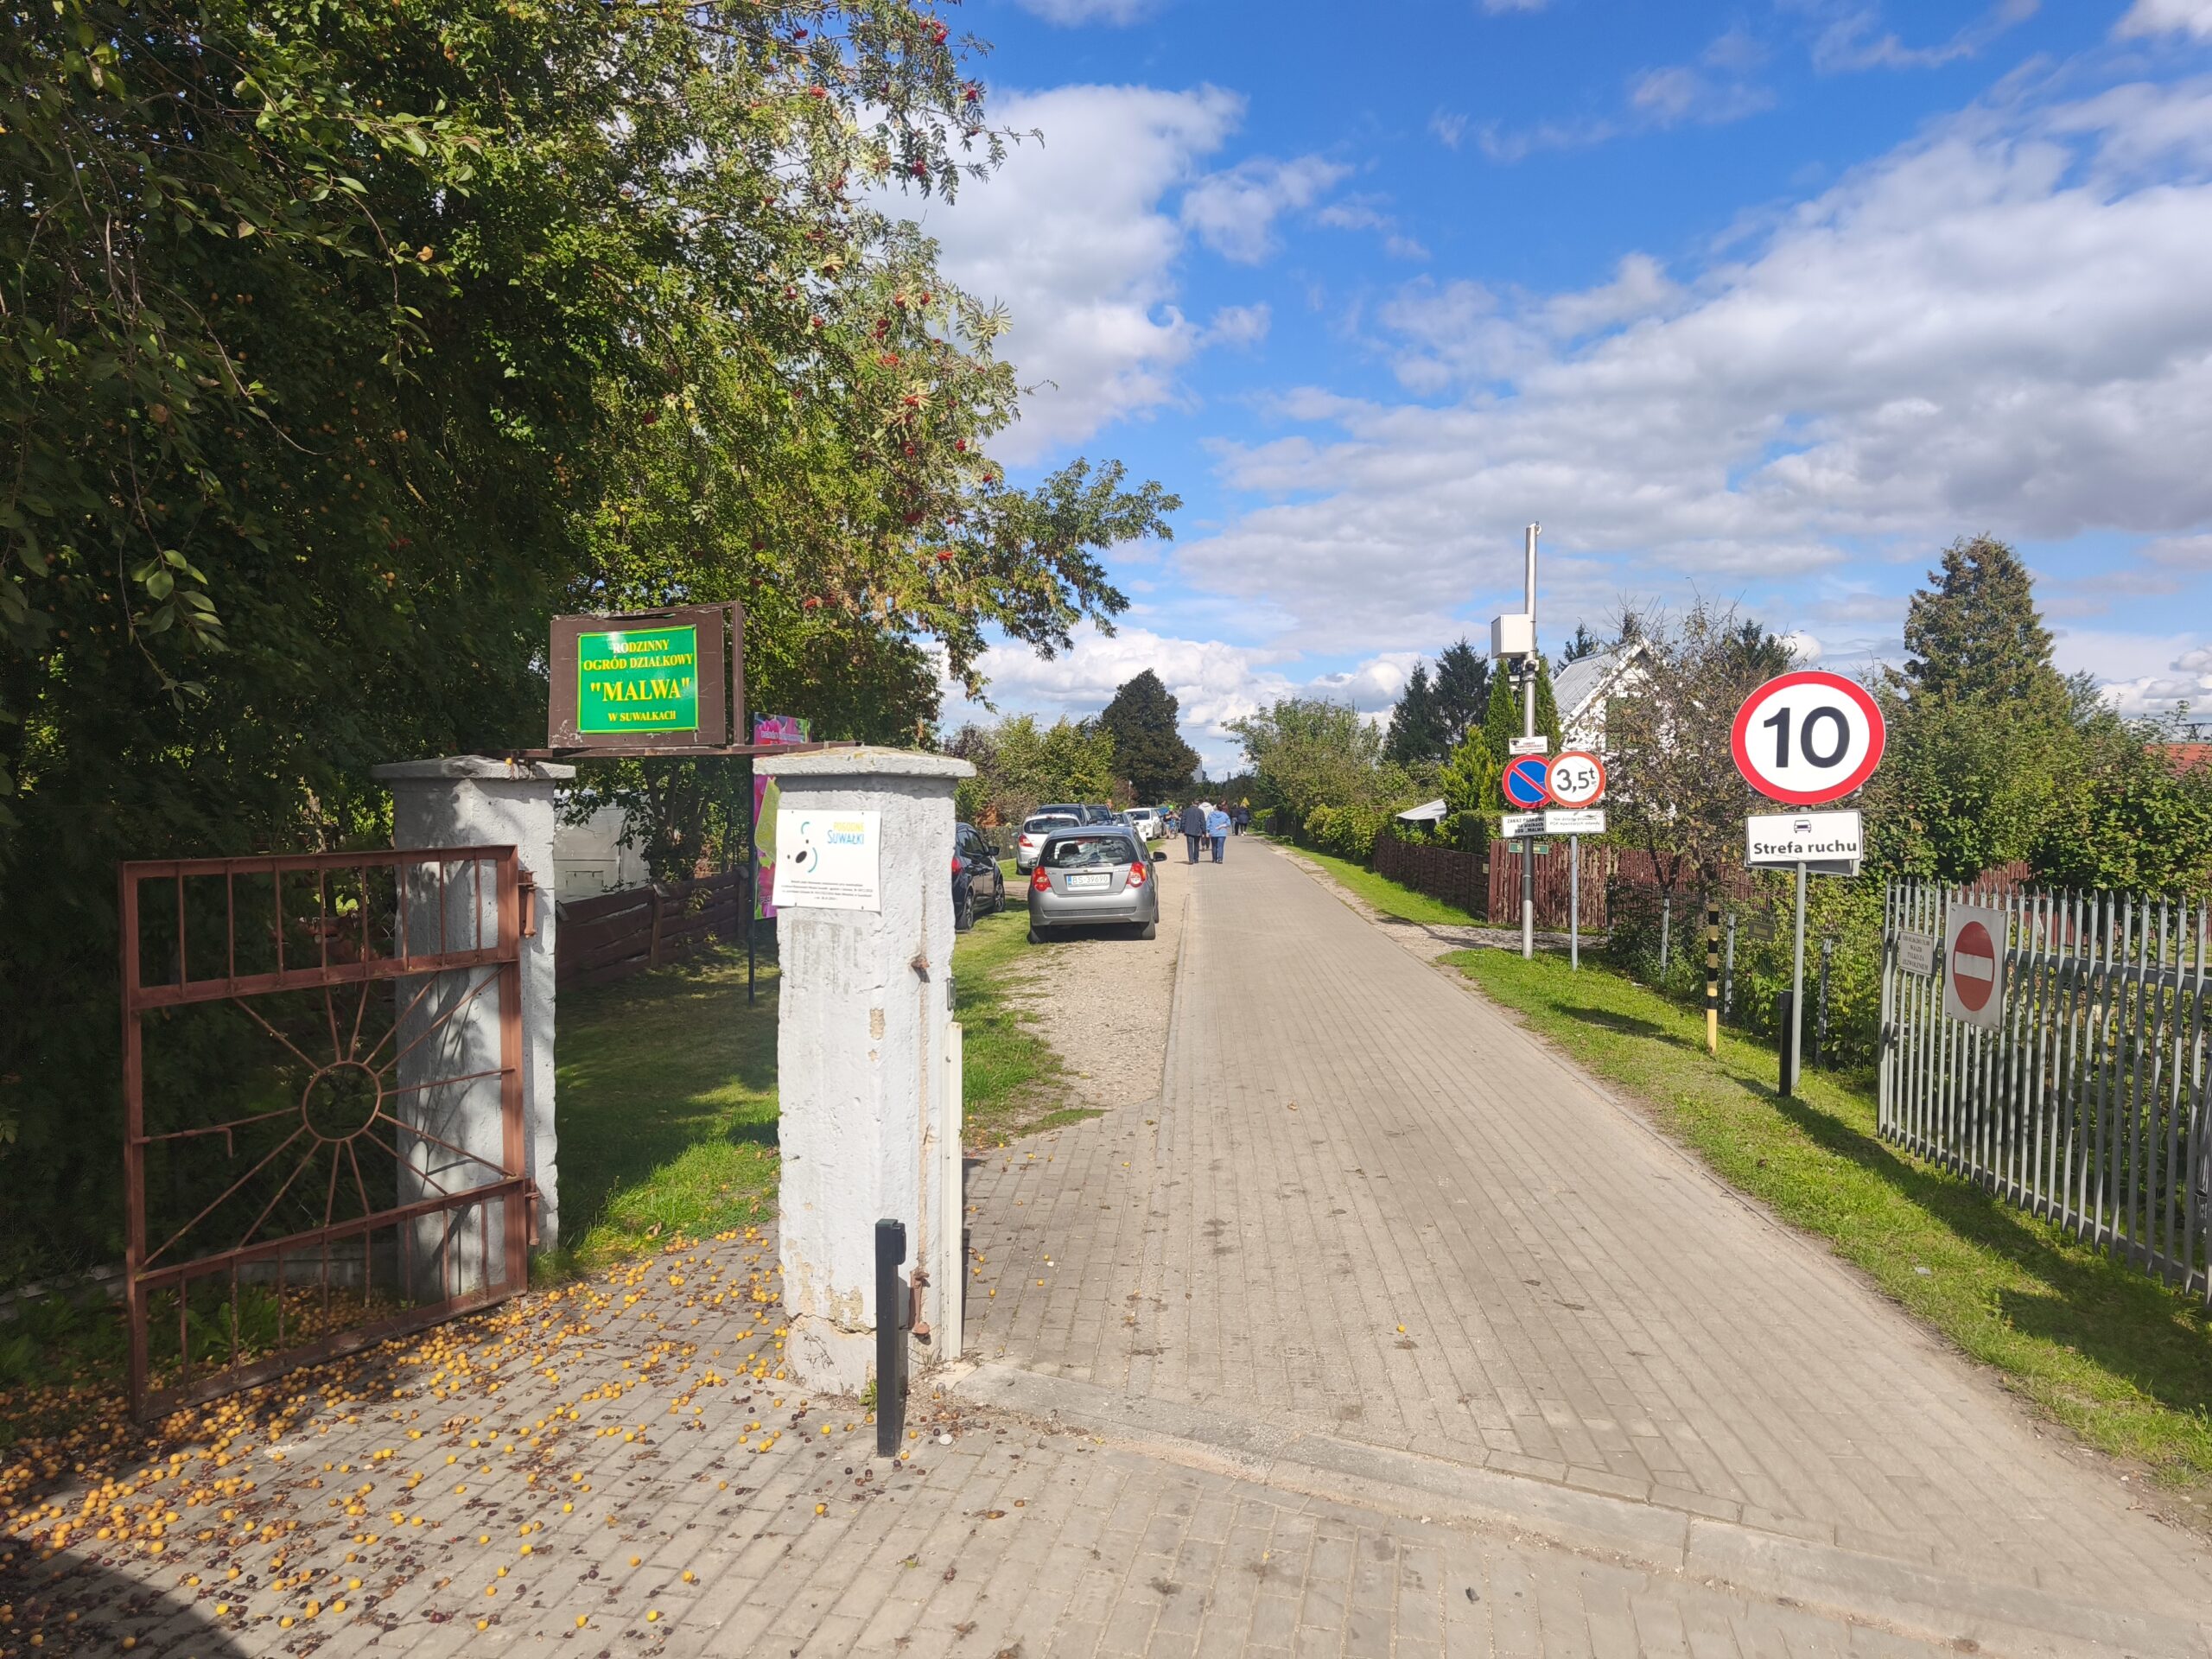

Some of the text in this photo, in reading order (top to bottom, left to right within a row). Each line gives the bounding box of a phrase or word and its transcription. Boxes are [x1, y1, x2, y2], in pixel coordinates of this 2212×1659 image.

[613, 639, 670, 654] RODZINNY
[583, 656, 627, 671] OGRÓD
[590, 677, 690, 702] "MALWA"
[608, 713, 618, 721] W
[1764, 706, 1851, 768] 10
[1753, 839, 1857, 855] Strefa ruchu
